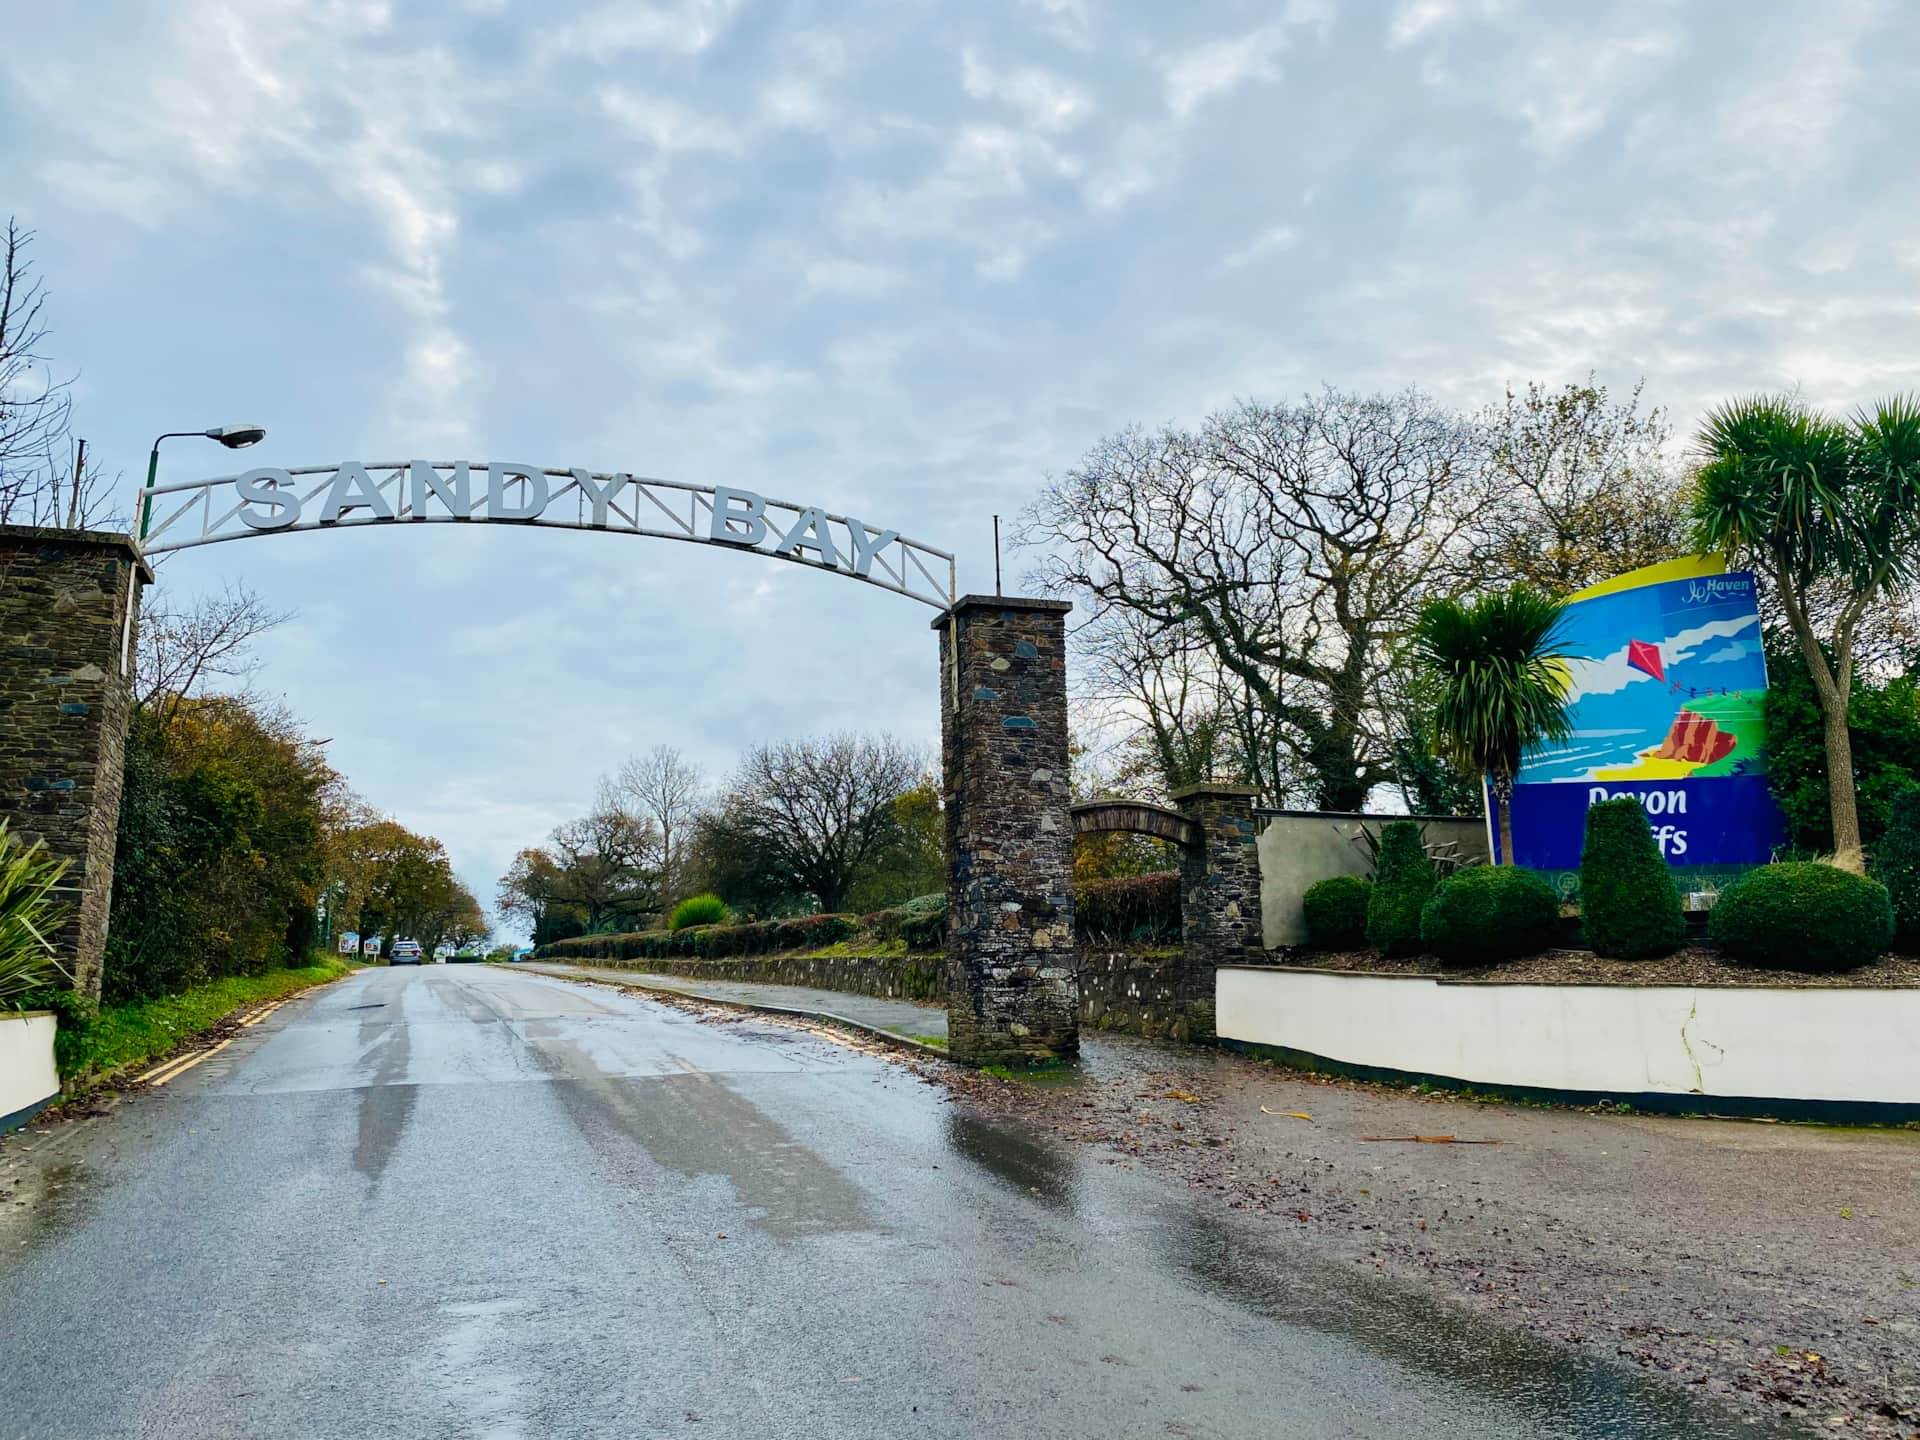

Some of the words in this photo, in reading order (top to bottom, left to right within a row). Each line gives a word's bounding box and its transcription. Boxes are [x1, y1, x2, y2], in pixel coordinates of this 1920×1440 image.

[235, 460, 631, 530] SANDY
[710, 485, 900, 578] BAY
[1706, 579, 1750, 591] Haven
